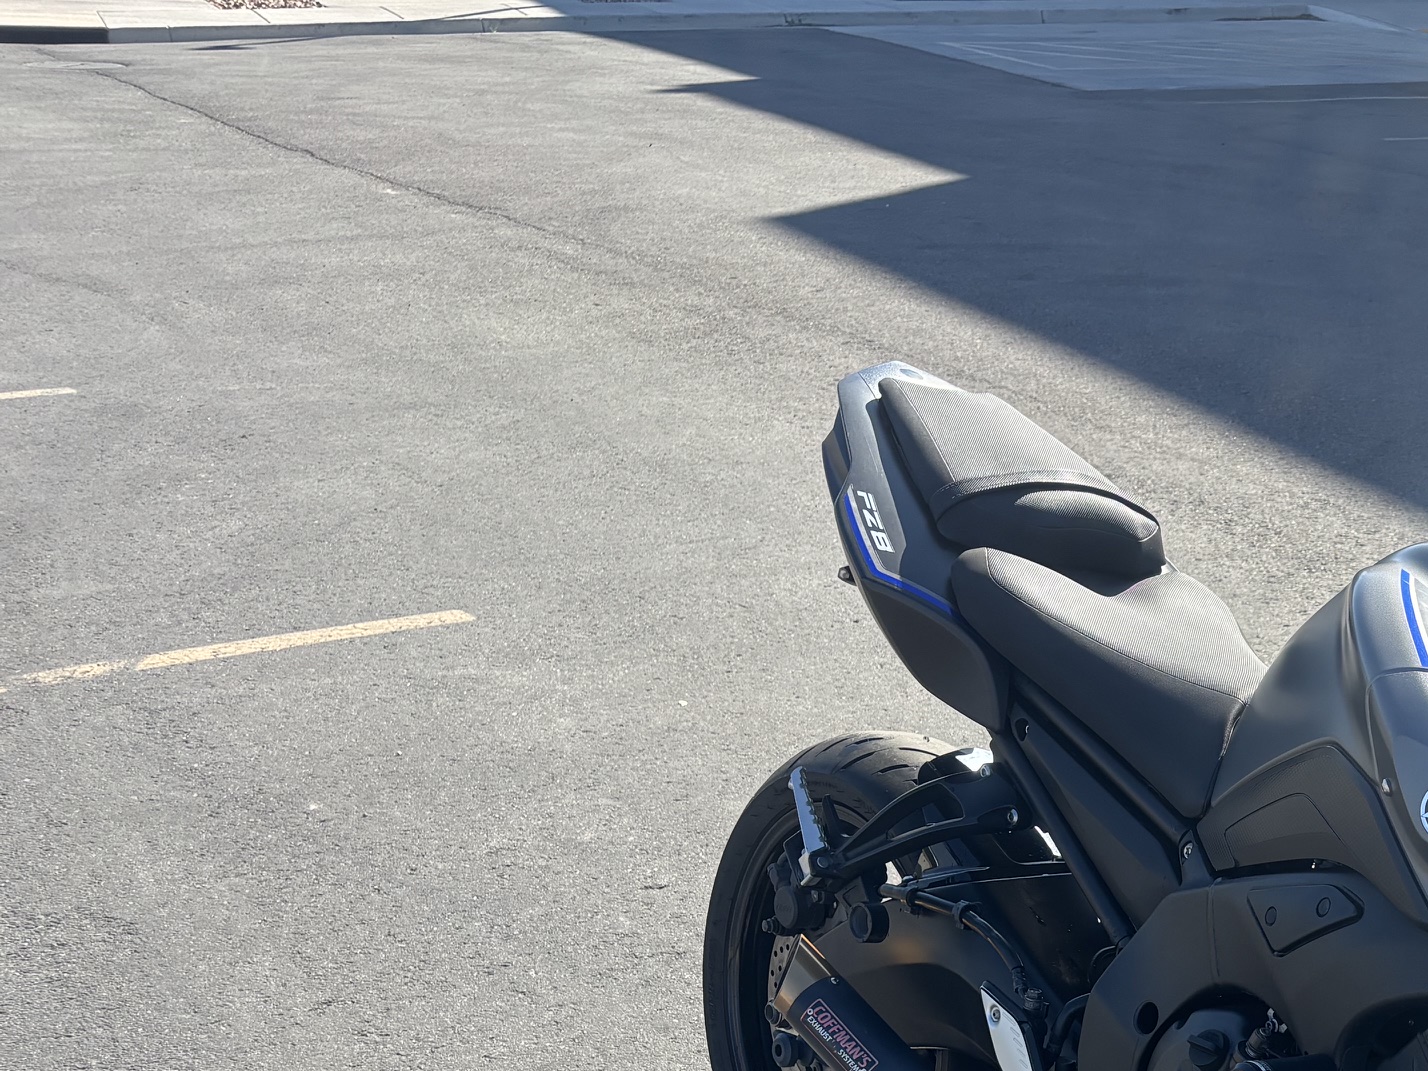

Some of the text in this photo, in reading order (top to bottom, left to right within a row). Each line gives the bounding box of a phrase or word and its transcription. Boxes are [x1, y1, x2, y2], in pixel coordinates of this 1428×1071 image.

[857, 490, 895, 553] FZ8
[806, 1016, 833, 1042] EXHAUST
[812, 1006, 872, 1067] COFFMAN'S
